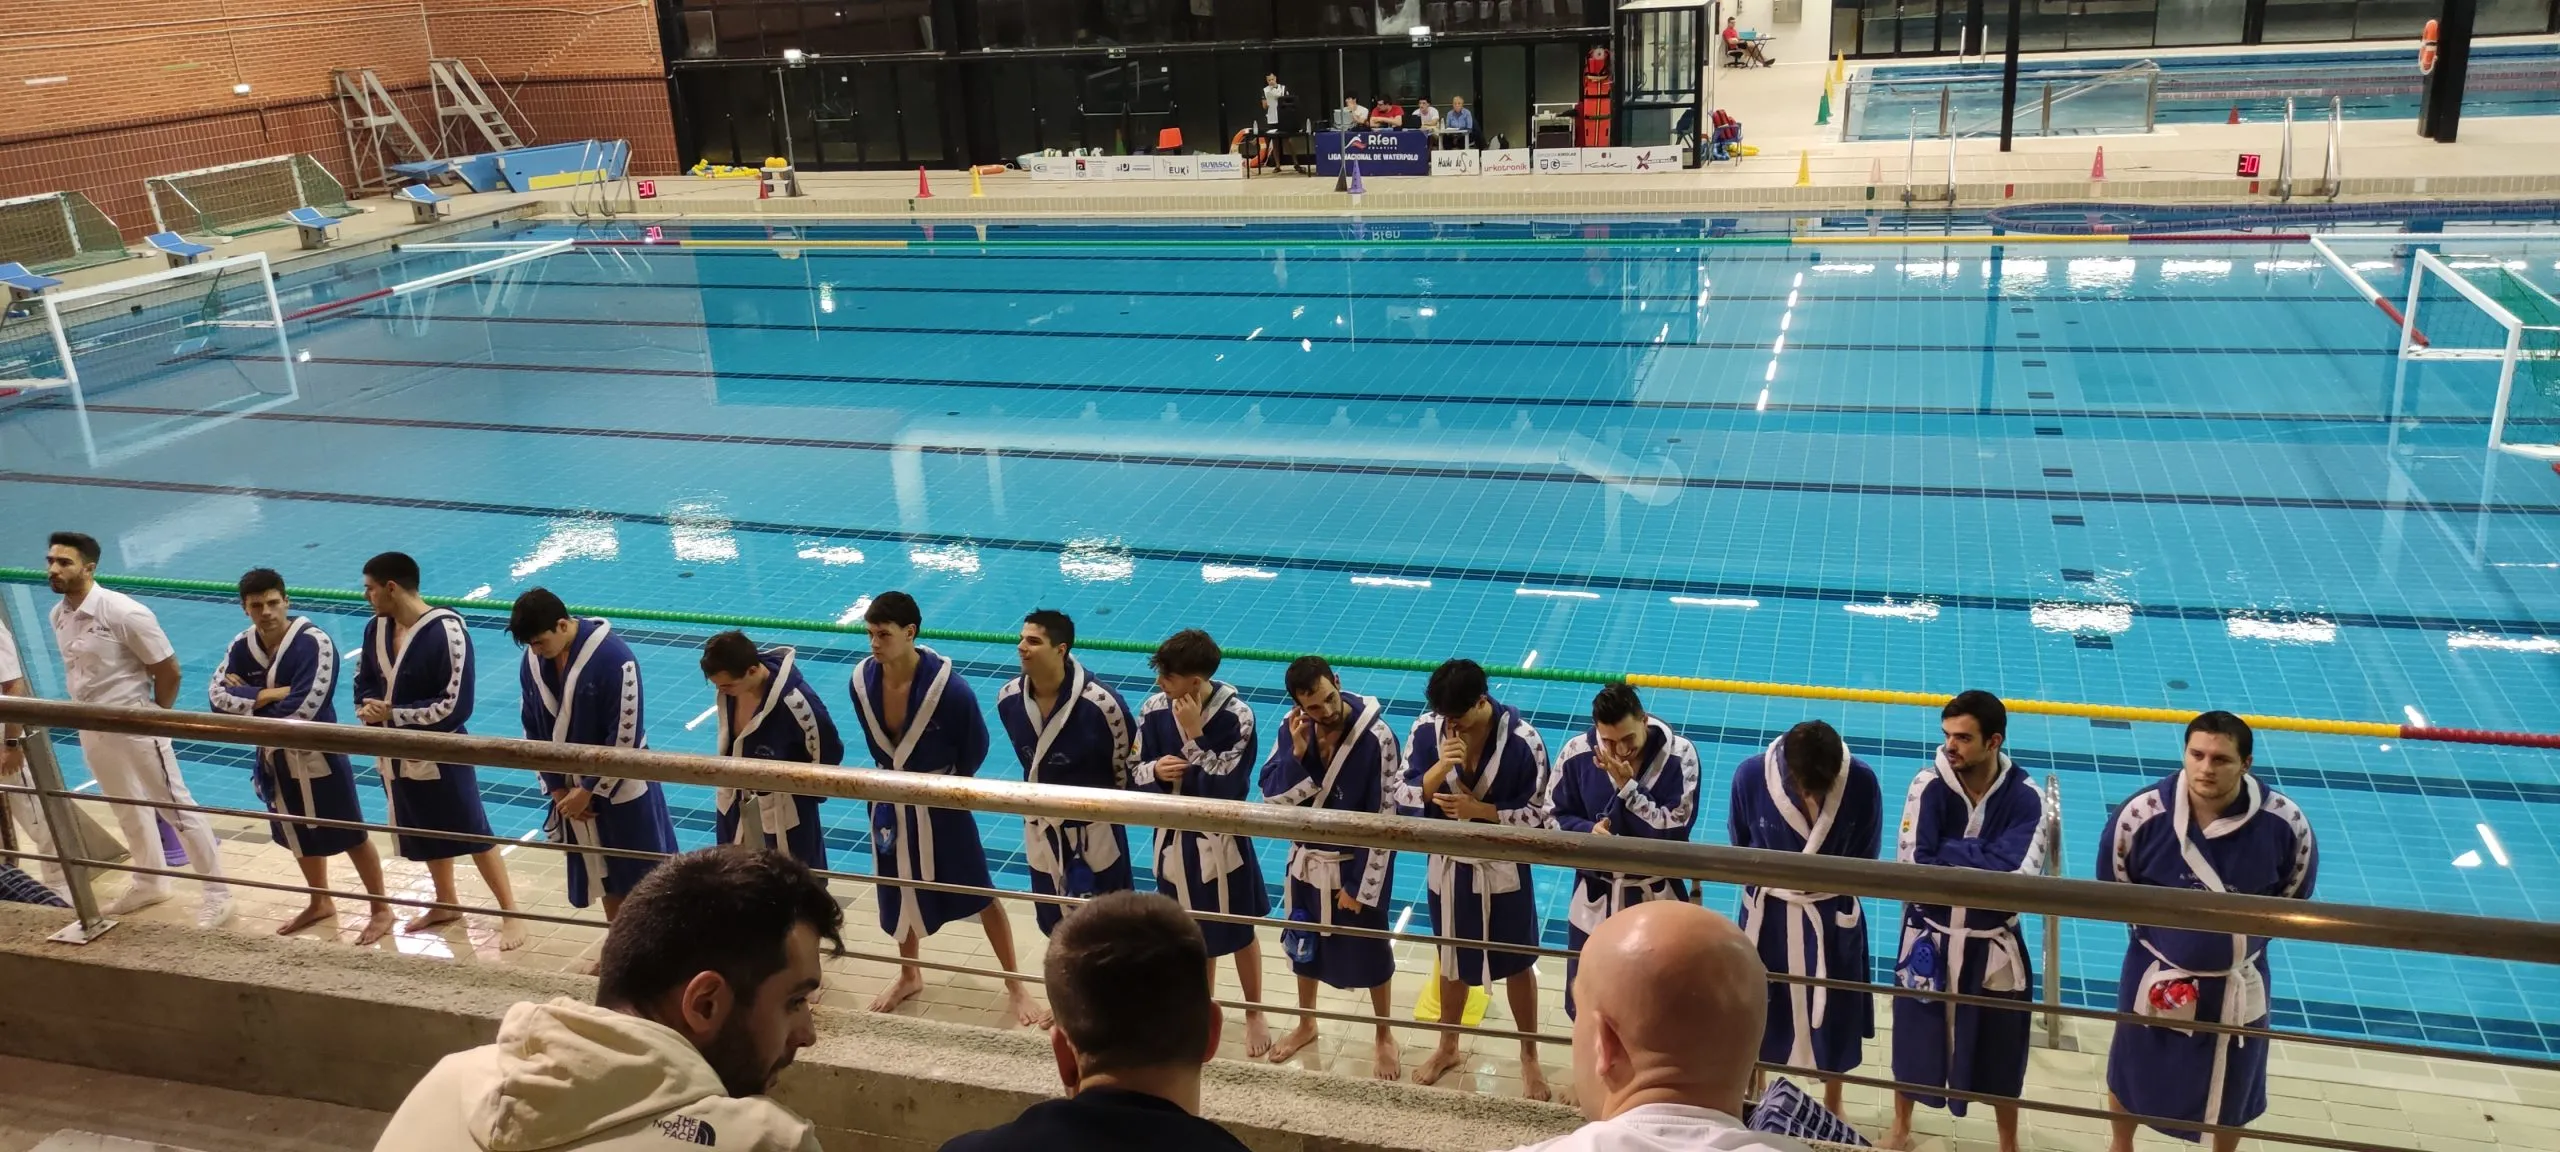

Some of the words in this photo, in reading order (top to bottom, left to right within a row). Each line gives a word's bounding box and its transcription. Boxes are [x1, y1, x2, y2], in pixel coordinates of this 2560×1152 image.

[1368, 134, 1397, 146] Rfen
[1484, 163, 1527, 172] urkotronik
[2239, 155, 2259, 173] 30
[639, 181, 655, 197] 30
[652, 1119, 696, 1137] NORTH
[677, 1114, 698, 1127] THE
[663, 1128, 694, 1143] FACE
